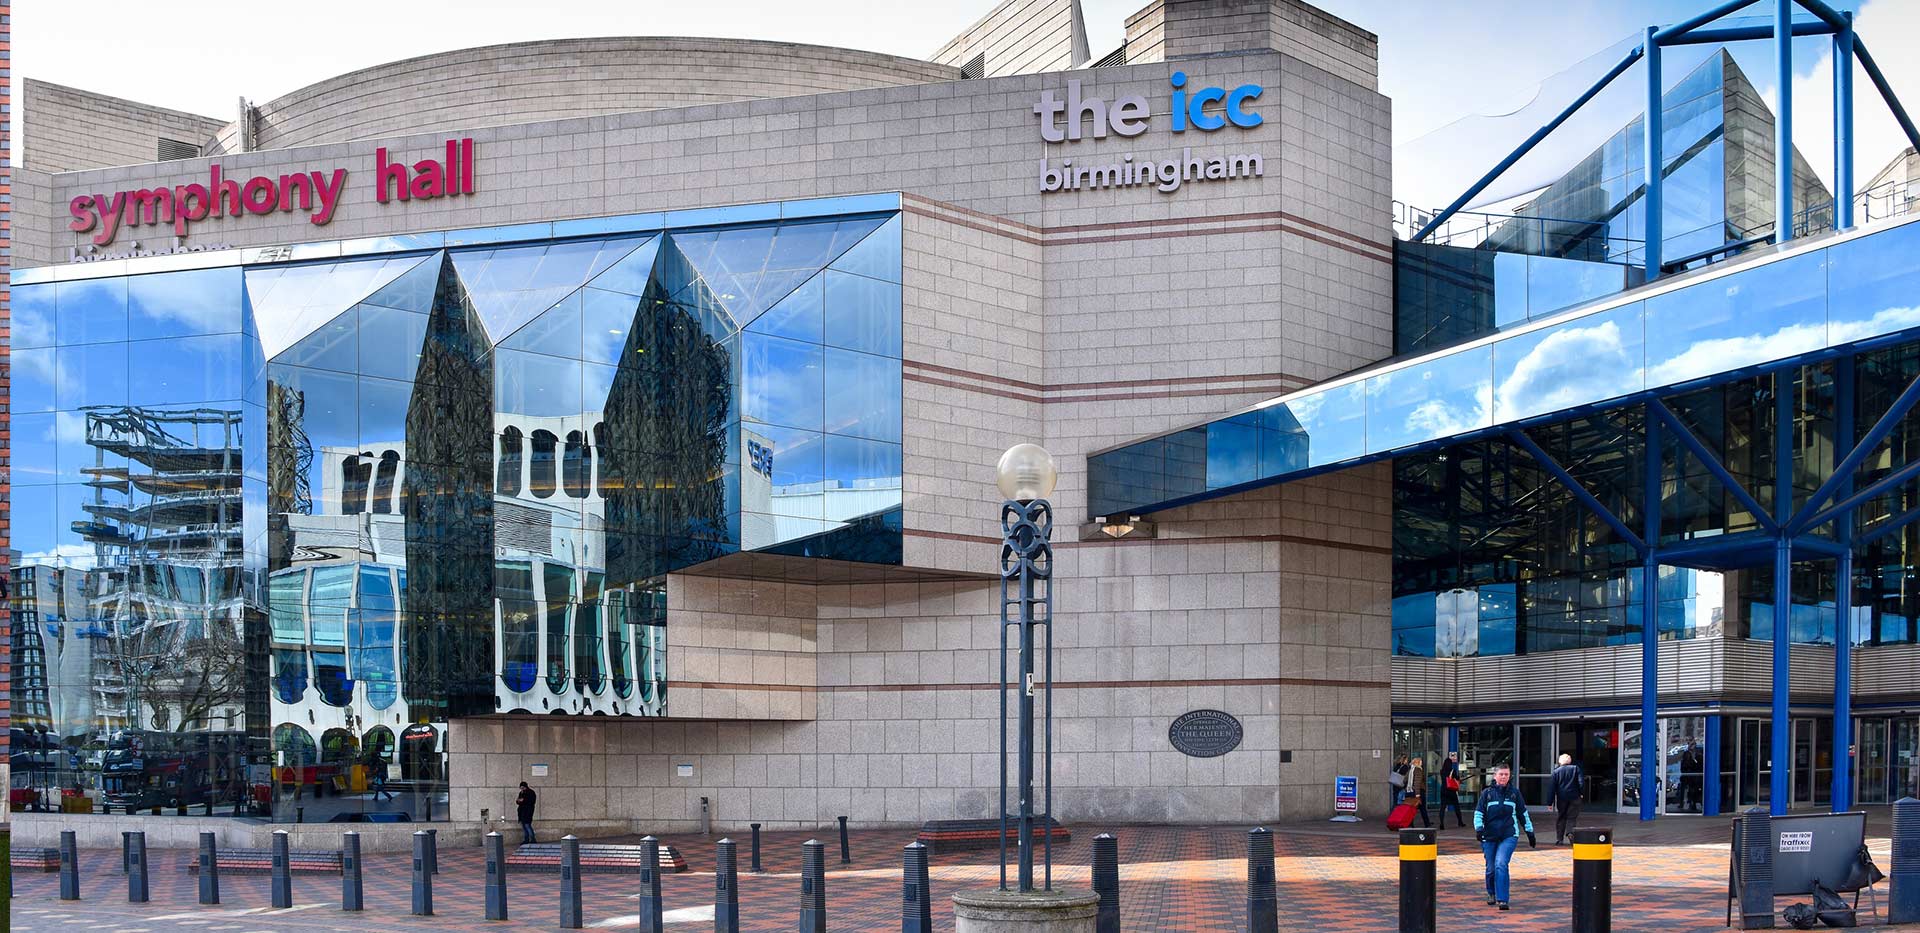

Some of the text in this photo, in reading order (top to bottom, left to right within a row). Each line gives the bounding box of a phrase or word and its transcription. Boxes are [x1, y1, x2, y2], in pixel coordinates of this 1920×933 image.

[1033, 71, 1264, 143] the icc
[68, 138, 475, 246] symphony hall
[1040, 148, 1263, 193] birmingham
[1172, 711, 1240, 731] THE INTERNATIONAL
[1171, 736, 1215, 757] CONVENTION
